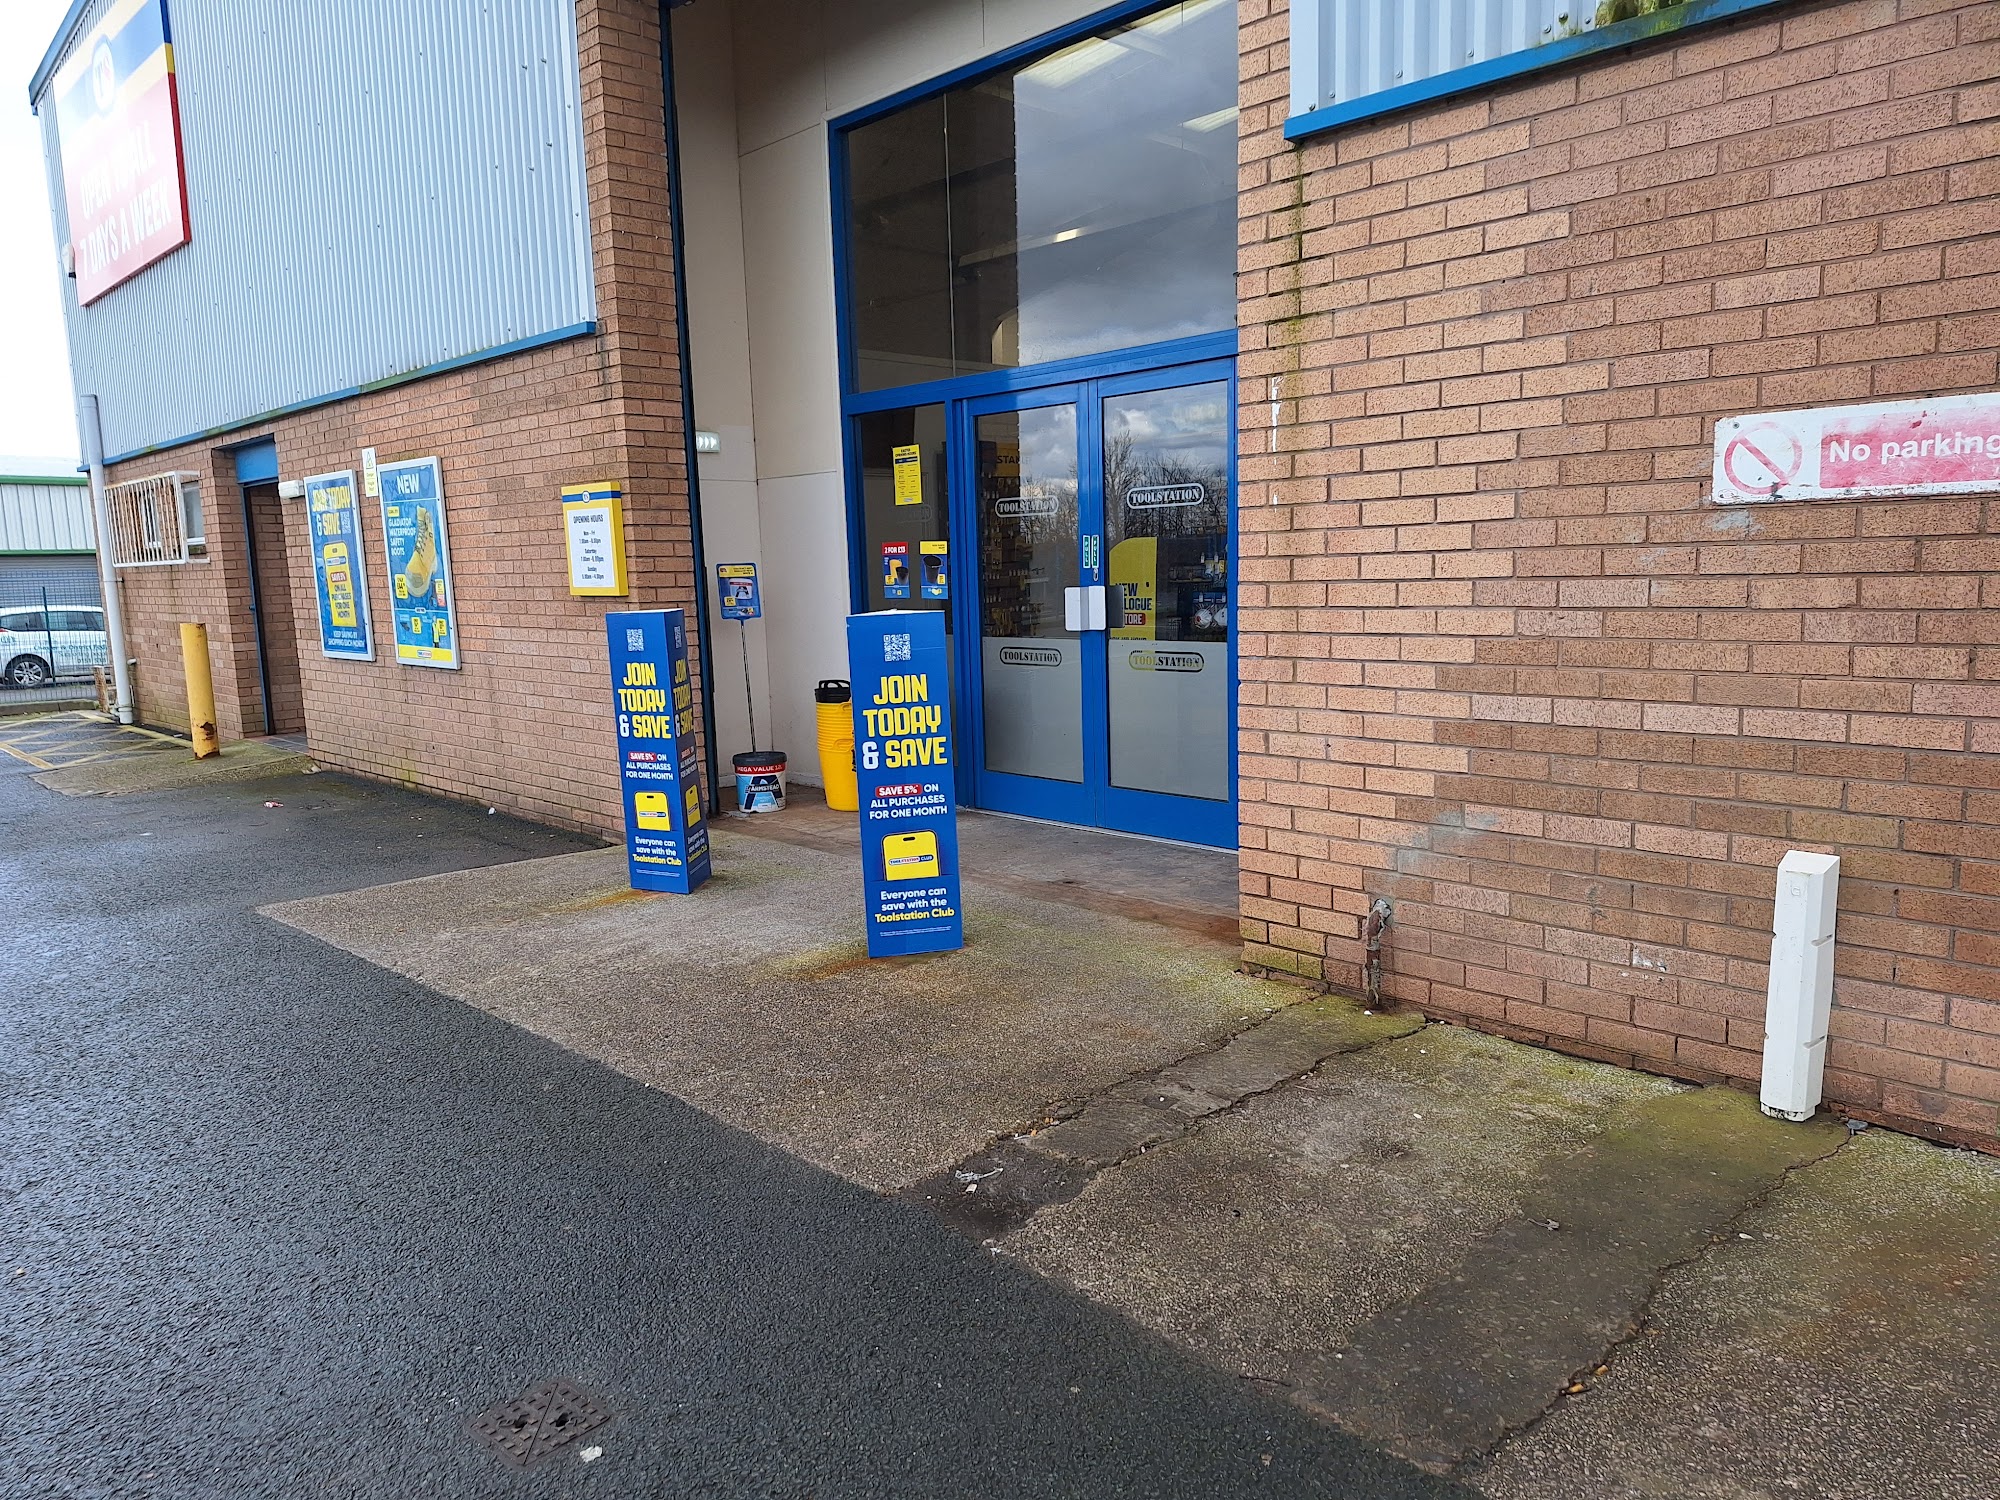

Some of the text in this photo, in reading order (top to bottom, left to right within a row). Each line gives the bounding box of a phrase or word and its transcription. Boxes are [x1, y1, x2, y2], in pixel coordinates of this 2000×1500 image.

[89, 215, 118, 274] DAYS
[120, 208, 130, 254] A
[129, 176, 172, 245] WEEK
[1829, 431, 2000, 465] No parking
[396, 473, 419, 494] NEW
[1131, 488, 1199, 504] TOOLSTATION
[999, 498, 1054, 512] TOOLSTATION
[316, 512, 341, 536] & SAVE
[573, 514, 603, 523] OPENING HOURS
[390, 538, 404, 546] SAFETY
[1003, 651, 1058, 663] TOOLSTATION
[1132, 655, 1200, 668] TOOLSTATION
[623, 662, 656, 686] JOIN
[675, 658, 687, 684] JOIN
[673, 683, 691, 711] TODAY
[873, 674, 928, 705] JOIN
[618, 689, 666, 712] TODAY
[619, 714, 672, 739] & SAVE
[675, 708, 694, 737] & SAVE
[863, 705, 942, 737] TODAY
[862, 741, 879, 770] &
[885, 736, 947, 768] SAVE
[637, 762, 671, 771] PURCHASES
[879, 786, 903, 796] SAVE
[924, 784, 938, 792] ON
[871, 794, 945, 808] ALL PURCHASES
[869, 806, 947, 819] FOR ONE MONTH
[635, 836, 663, 846] Everyone
[632, 854, 682, 866] Toolstation Club
[880, 888, 946, 900] Everyone can
[882, 898, 947, 911] save with the
[875, 907, 955, 923] Toolstation Club
